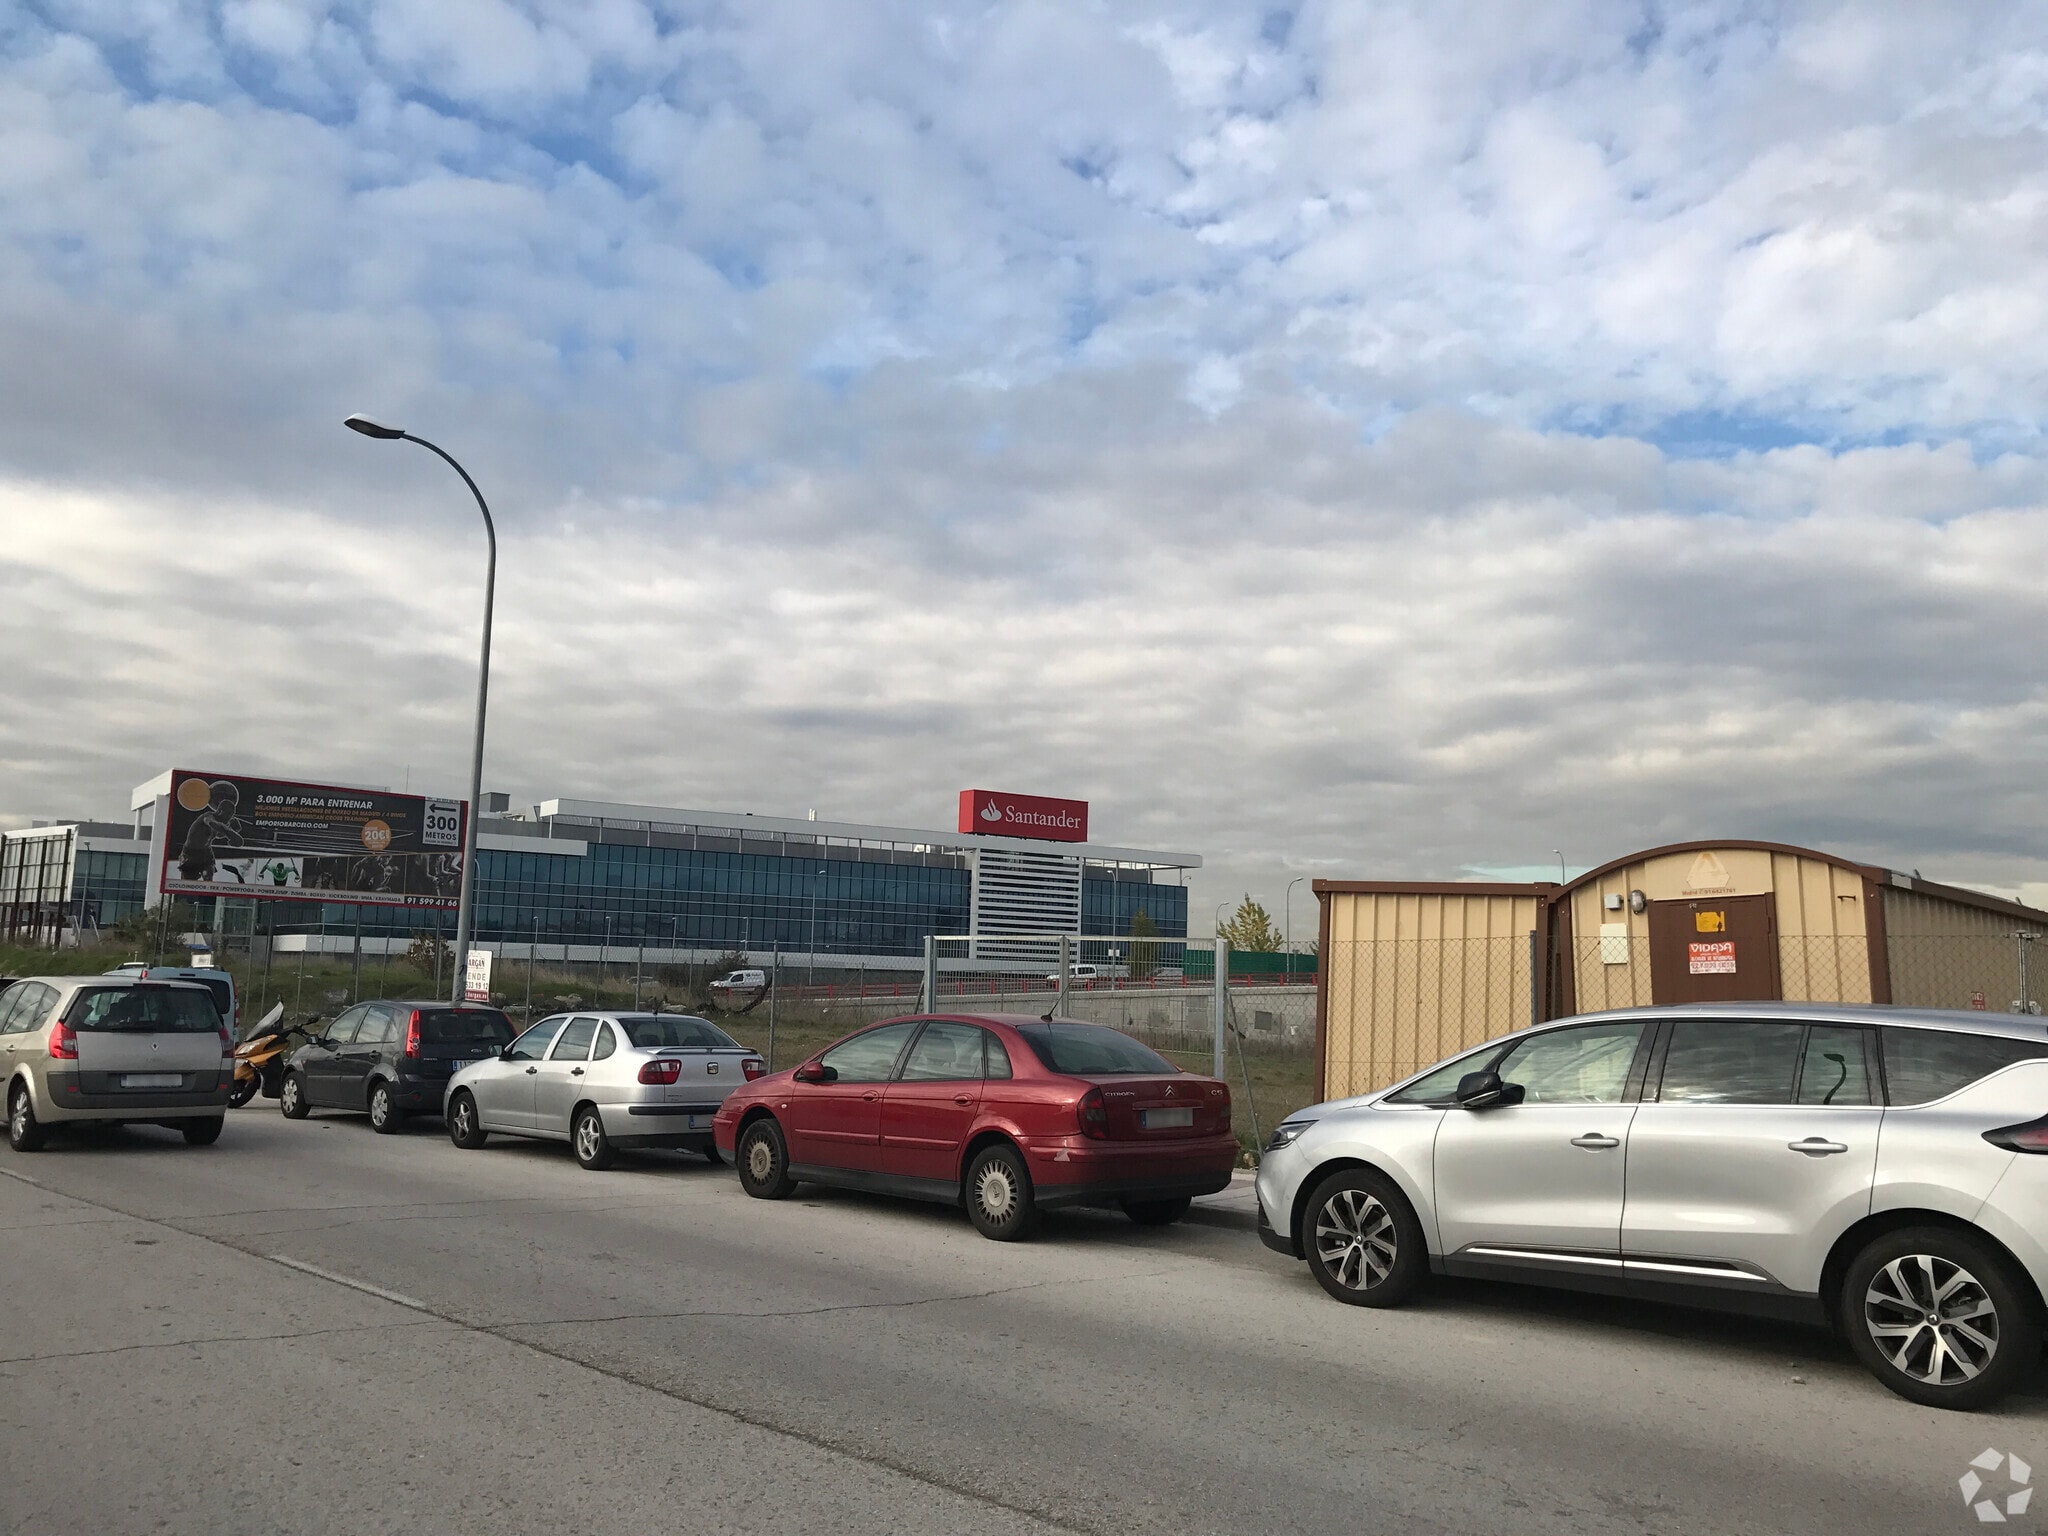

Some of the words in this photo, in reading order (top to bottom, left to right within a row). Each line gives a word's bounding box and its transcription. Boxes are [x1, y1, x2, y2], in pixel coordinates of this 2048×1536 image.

[256, 795, 283, 804] 3.000
[300, 798, 325, 807] PARA
[327, 799, 374, 809] ENTRENAR
[1005, 805, 1082, 829] Santander
[255, 820, 329, 829] EMPORIOBARCELO.COM
[426, 815, 457, 831] 300
[364, 830, 386, 841] 20€
[425, 832, 456, 840] METROS
[407, 897, 417, 905] 91
[419, 898, 435, 906] 599
[447, 899, 459, 907] 66
[469, 959, 485, 967] ARGAN
[468, 972, 486, 981] ENDE
